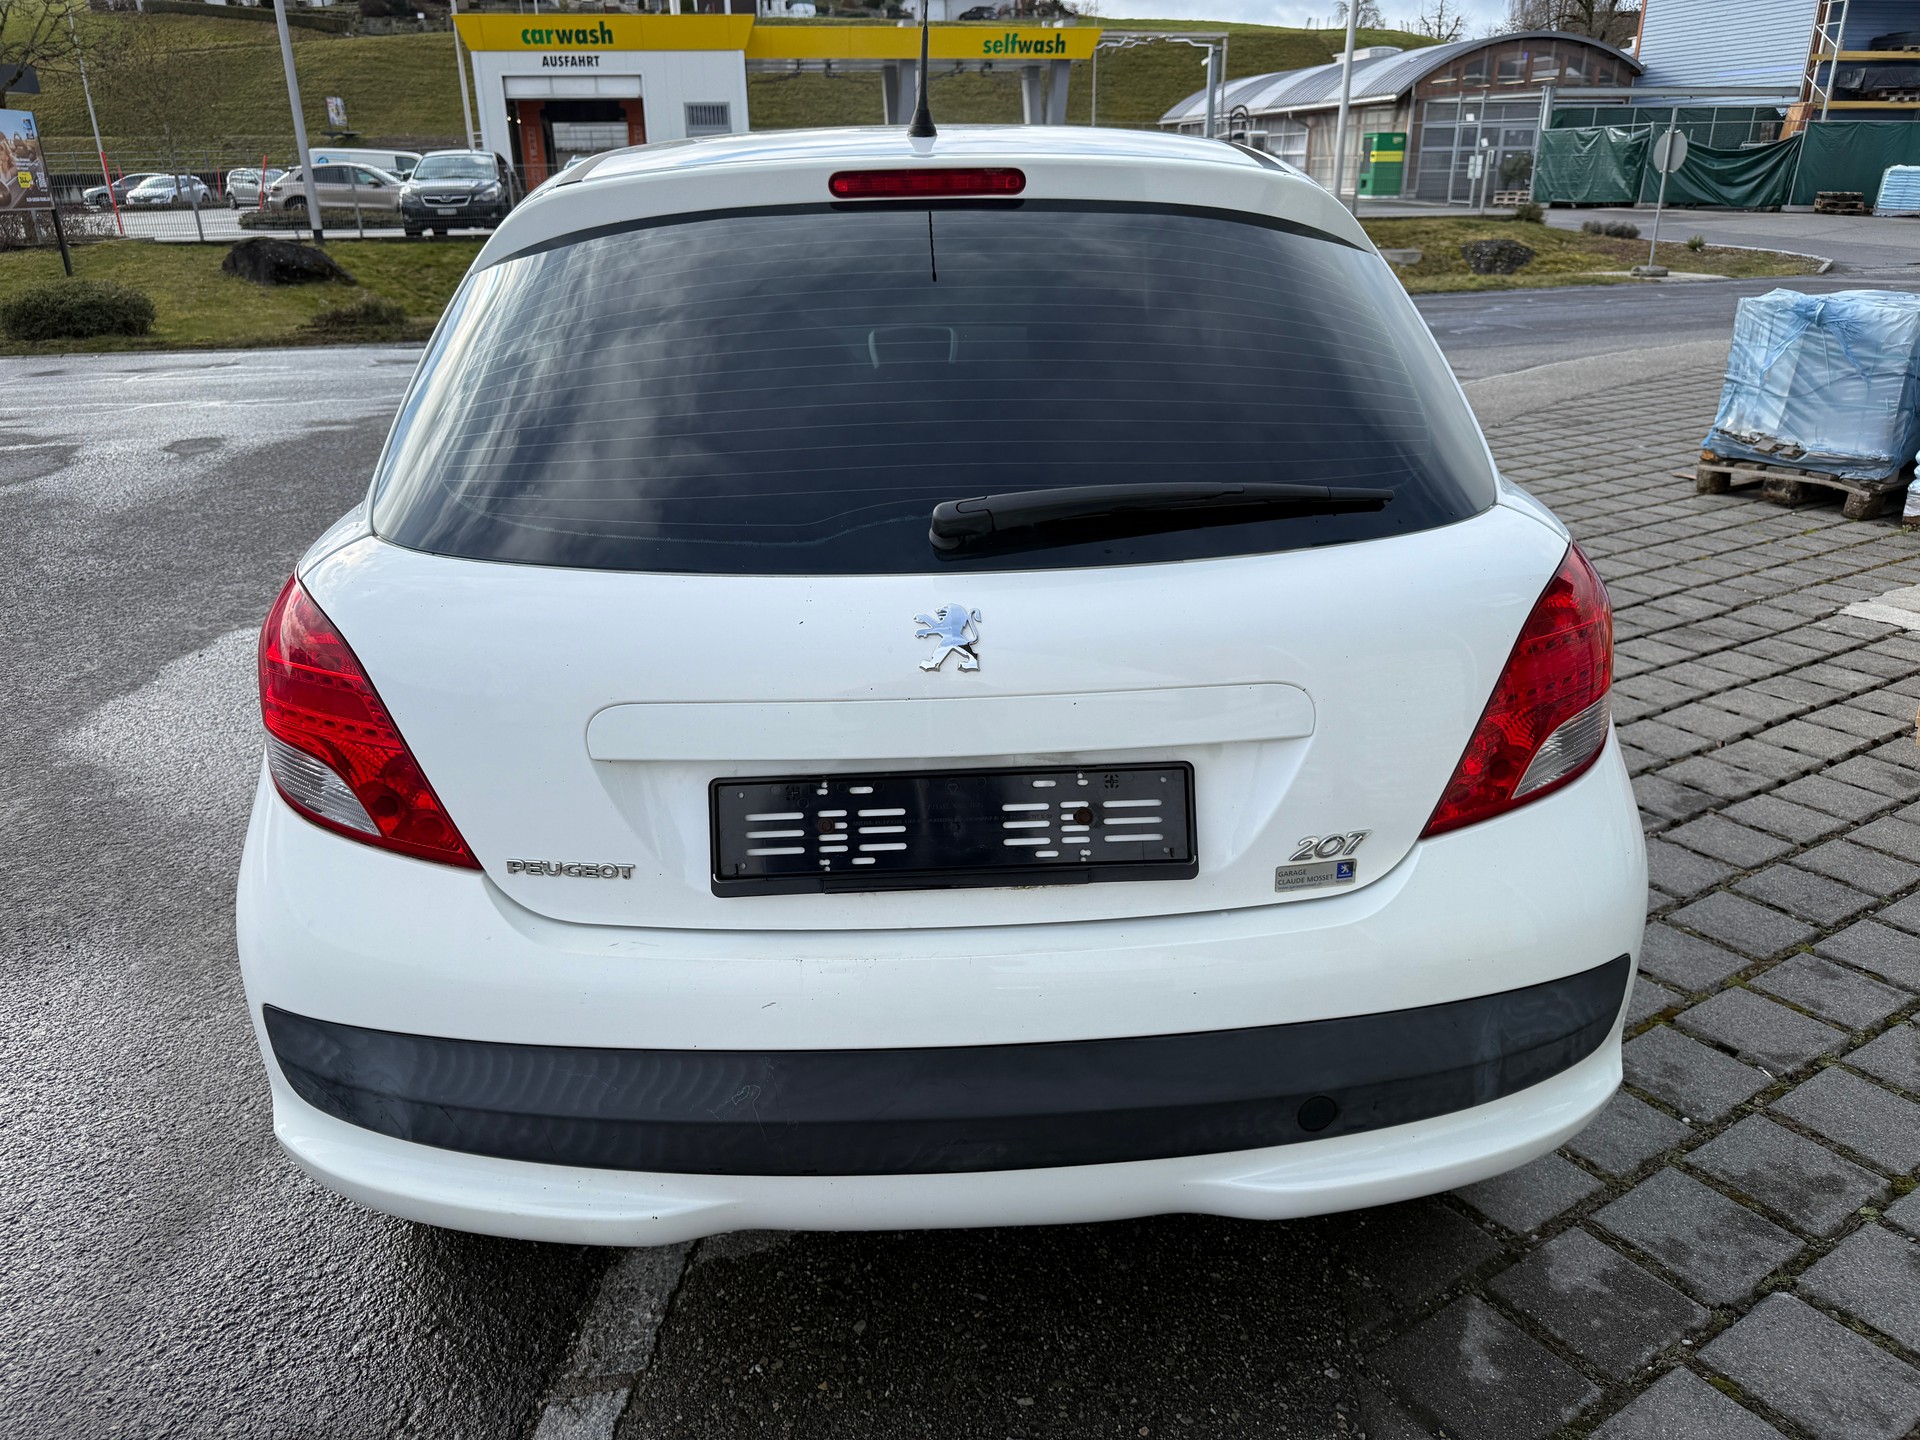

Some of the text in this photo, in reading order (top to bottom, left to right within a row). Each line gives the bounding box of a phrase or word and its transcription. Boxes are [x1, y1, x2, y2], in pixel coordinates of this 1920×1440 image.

[521, 20, 614, 45] carwash
[983, 33, 1066, 54] selfwash
[542, 55, 600, 68] AUSFAHRT
[1288, 829, 1373, 861] 207
[506, 858, 636, 880] PEUGEOT
[1278, 869, 1306, 877] GARAGE
[1278, 876, 1304, 885] CLAUDE
[1307, 874, 1333, 882] MOSSET
